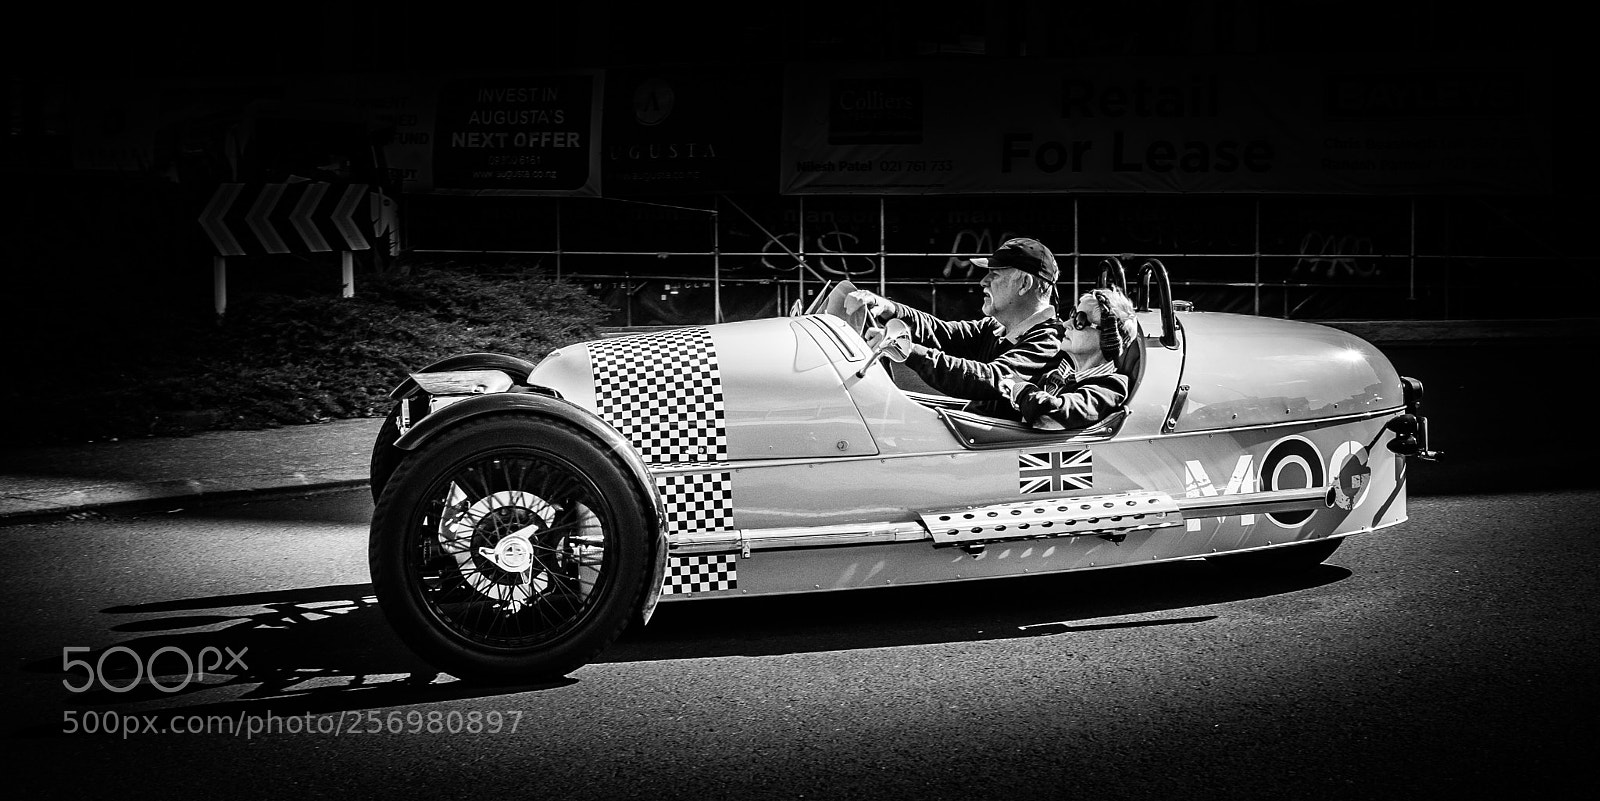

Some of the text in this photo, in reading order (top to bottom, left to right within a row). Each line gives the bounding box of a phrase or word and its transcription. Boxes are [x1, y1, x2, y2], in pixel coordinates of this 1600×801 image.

[477, 88, 559, 102] INVEST IN
[840, 90, 913, 110] Colliers
[1061, 74, 1217, 118] Retail
[468, 109, 565, 125] AUGUSTA'S
[451, 132, 581, 148] NEXT OFFER
[1002, 132, 1274, 172] For Lease
[797, 161, 835, 172] Nilesh
[839, 161, 872, 172] Patel
[880, 161, 901, 172] 021
[931, 160, 953, 172] 733
